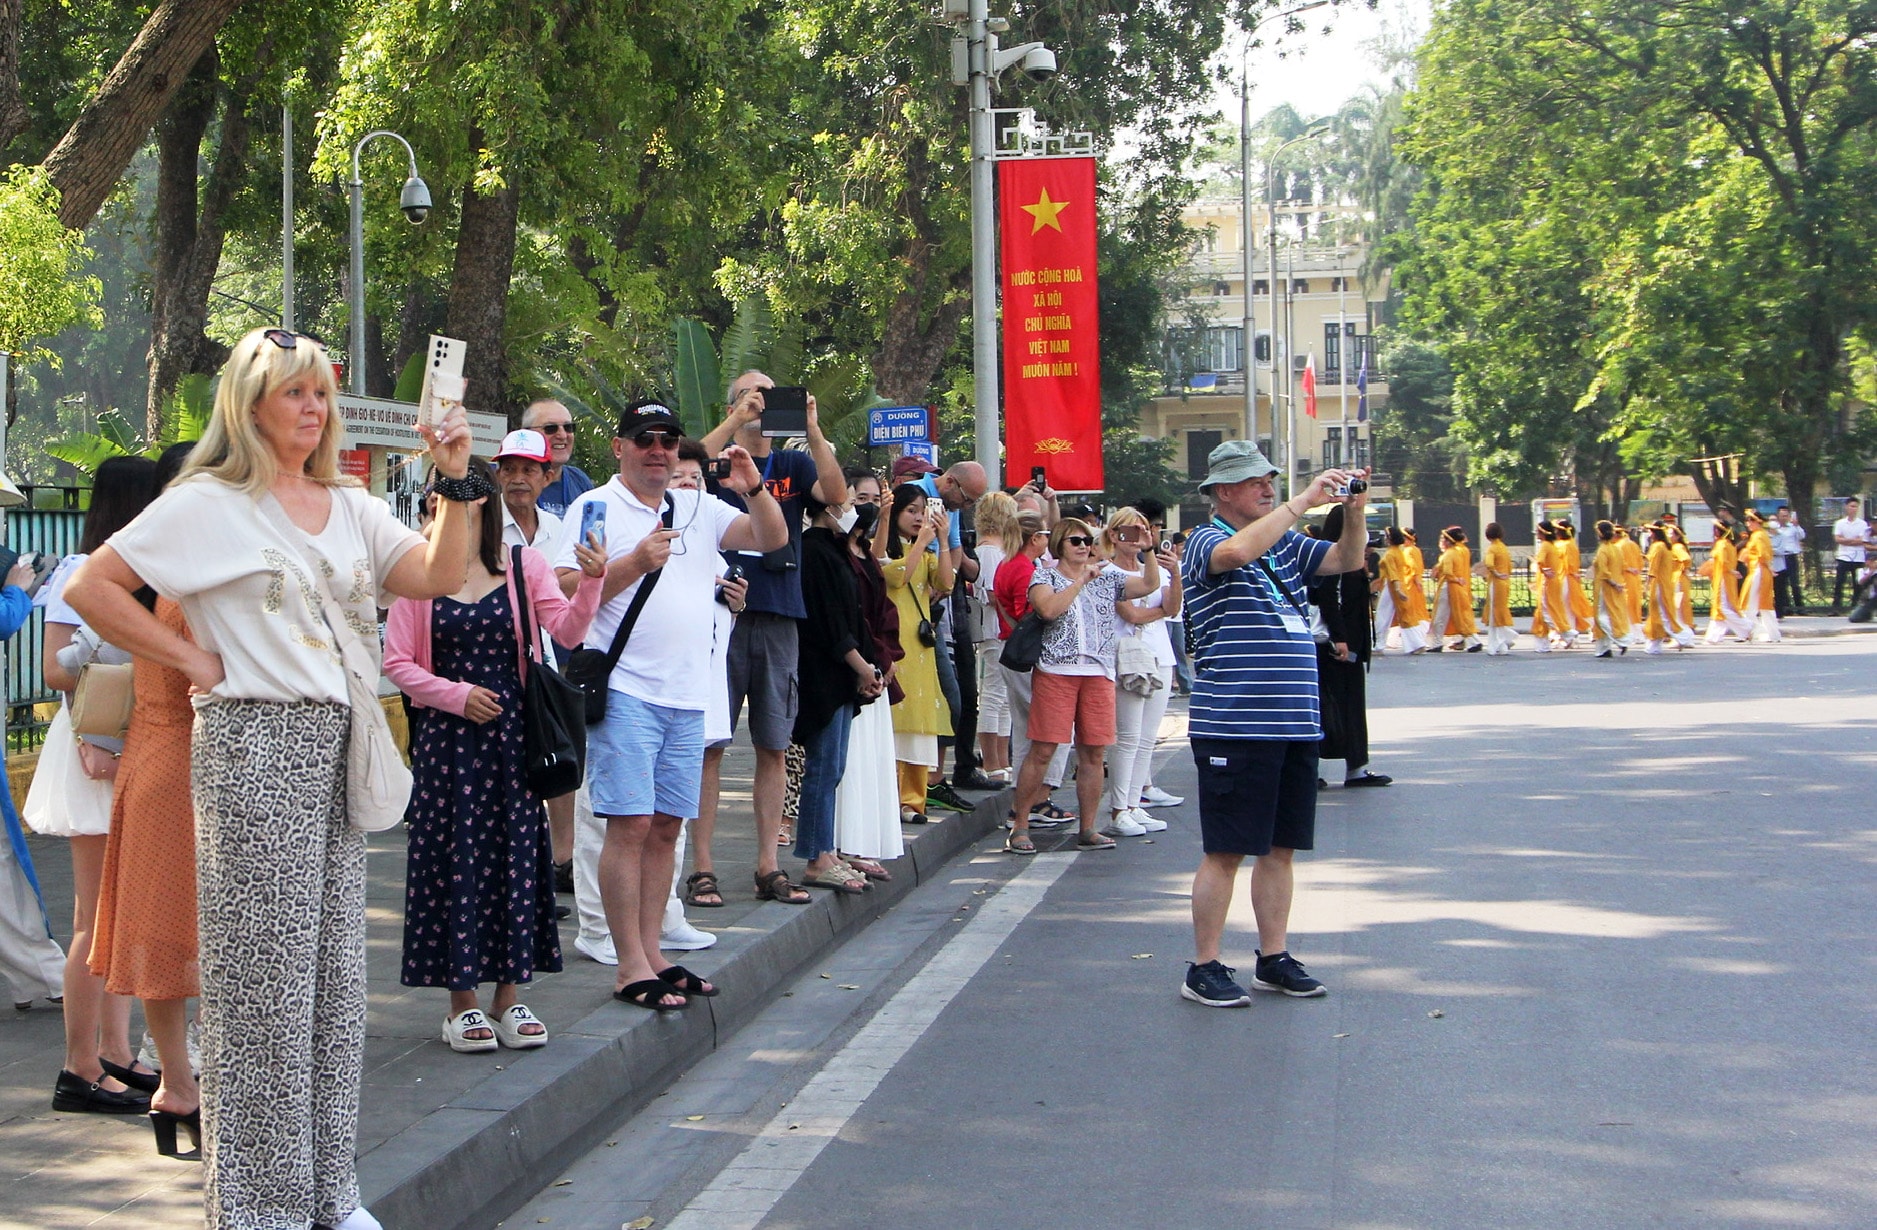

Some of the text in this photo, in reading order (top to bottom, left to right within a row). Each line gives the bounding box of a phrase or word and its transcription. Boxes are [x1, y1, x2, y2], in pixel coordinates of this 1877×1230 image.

[1011, 268, 1036, 287] NƯỚC
[1038, 267, 1062, 287] CỘNG
[1033, 289, 1062, 309] XÃ HỘI
[1025, 312, 1072, 332] CHỦ NGHĨA
[1028, 338, 1070, 357] VIỆT NAM
[1022, 361, 1050, 379] MUÔN
[1052, 360, 1072, 377] NĂM
[910, 419, 925, 437] PHỦ
